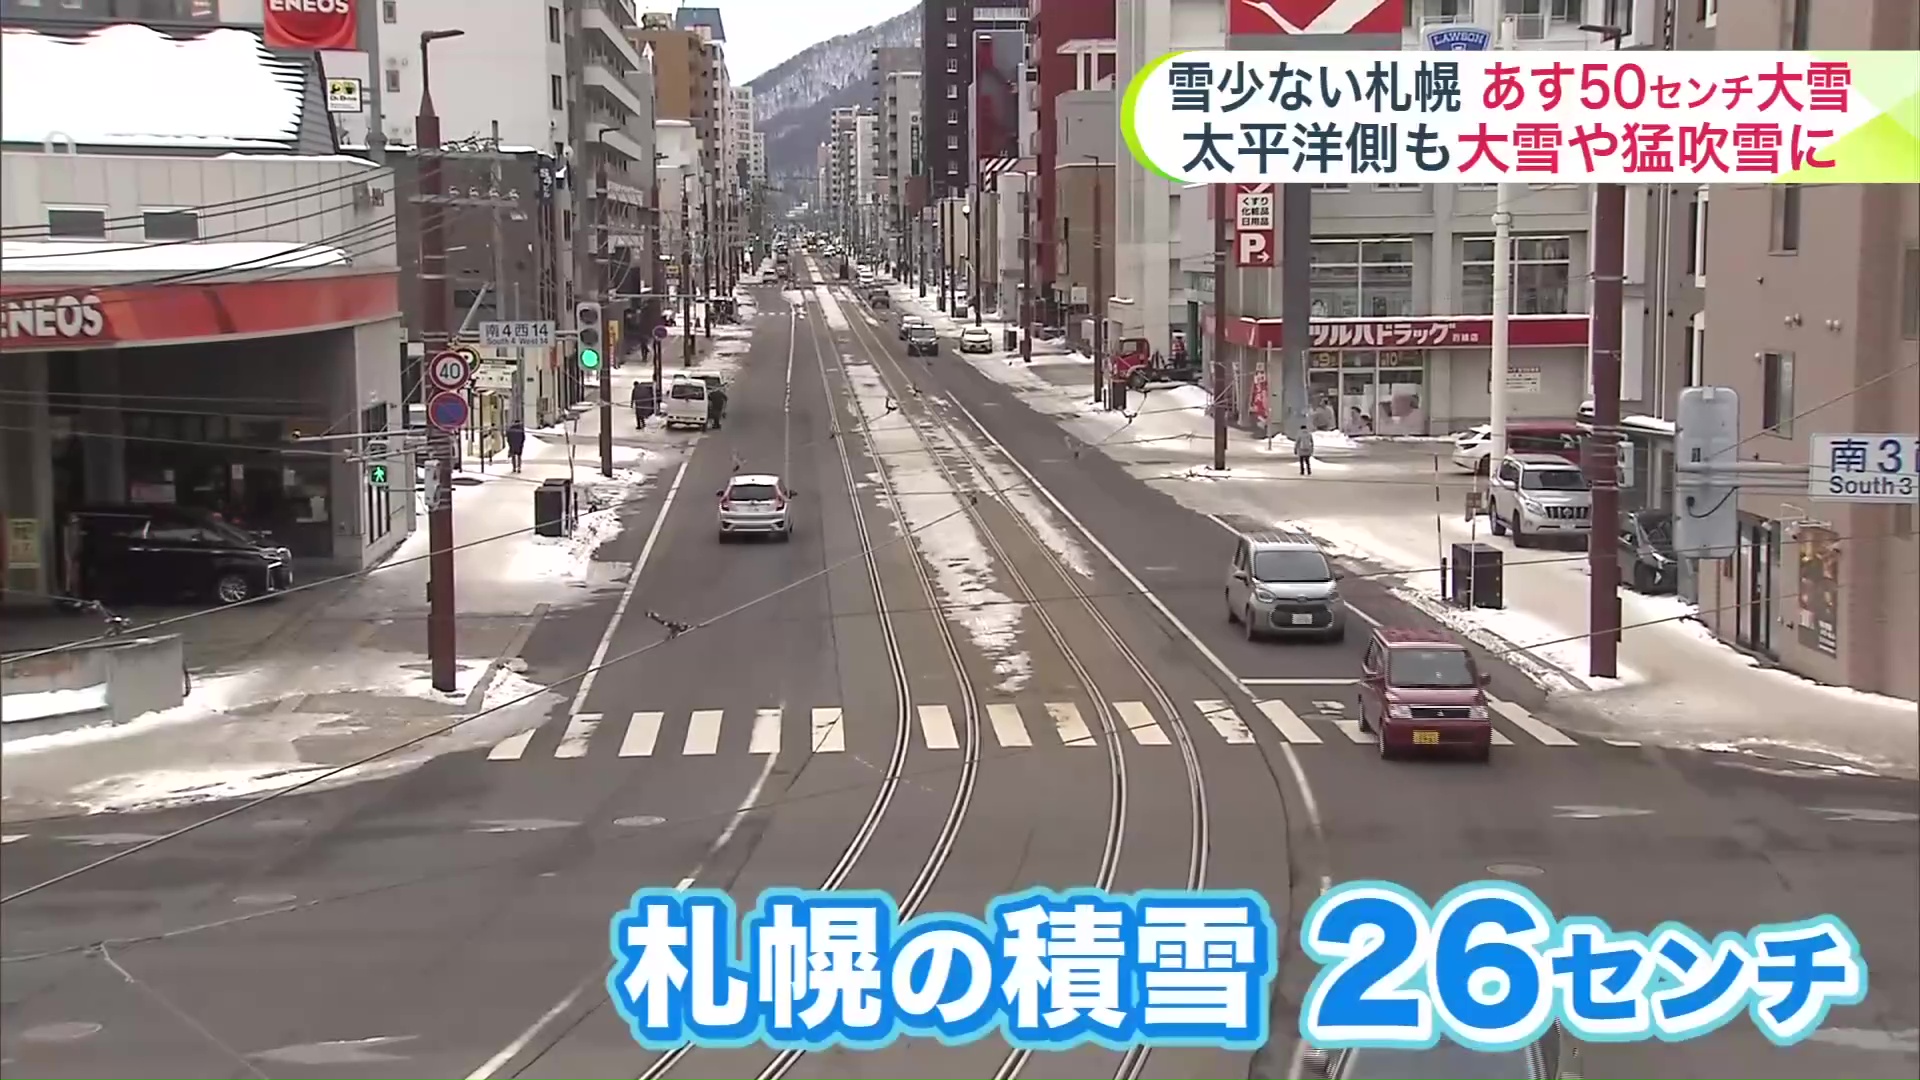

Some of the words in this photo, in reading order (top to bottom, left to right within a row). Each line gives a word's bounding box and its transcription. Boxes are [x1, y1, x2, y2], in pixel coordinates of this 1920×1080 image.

[270, 0, 349, 14] ENEOS
[1433, 32, 1484, 45] LAWSON
[1242, 197, 1269, 206] くすり
[1242, 207, 1269, 216] 化粧品
[1242, 217, 1269, 226] 日用品
[1240, 233, 1266, 263] P
[1309, 323, 1456, 345] ツルハドラッグ
[440, 362, 460, 379] 40
[1830, 438, 1919, 473] 南3
[1829, 476, 1894, 494] South
[1899, 477, 1913, 495] 3
